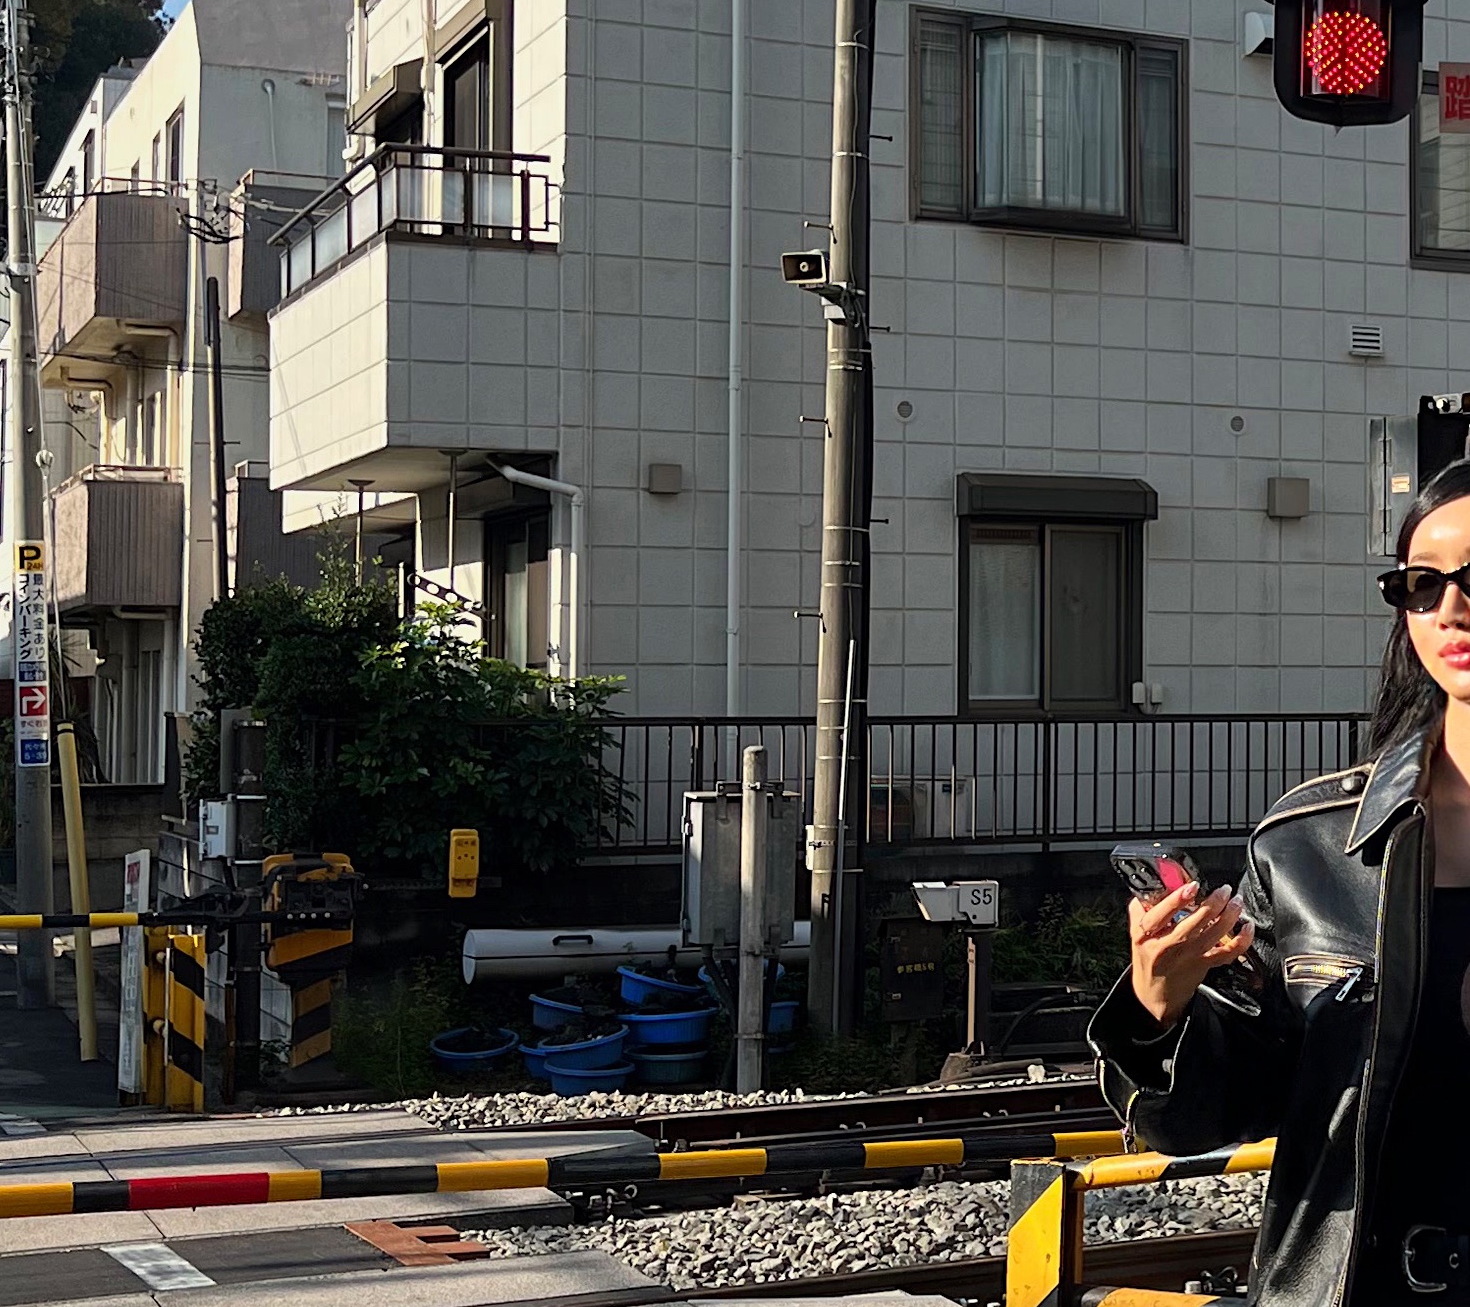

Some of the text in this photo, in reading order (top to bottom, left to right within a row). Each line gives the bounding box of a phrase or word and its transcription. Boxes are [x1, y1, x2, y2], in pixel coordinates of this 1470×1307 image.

[19, 546, 41, 569] P
[19, 573, 31, 660] コインパーキング
[971, 888, 992, 906] S5
